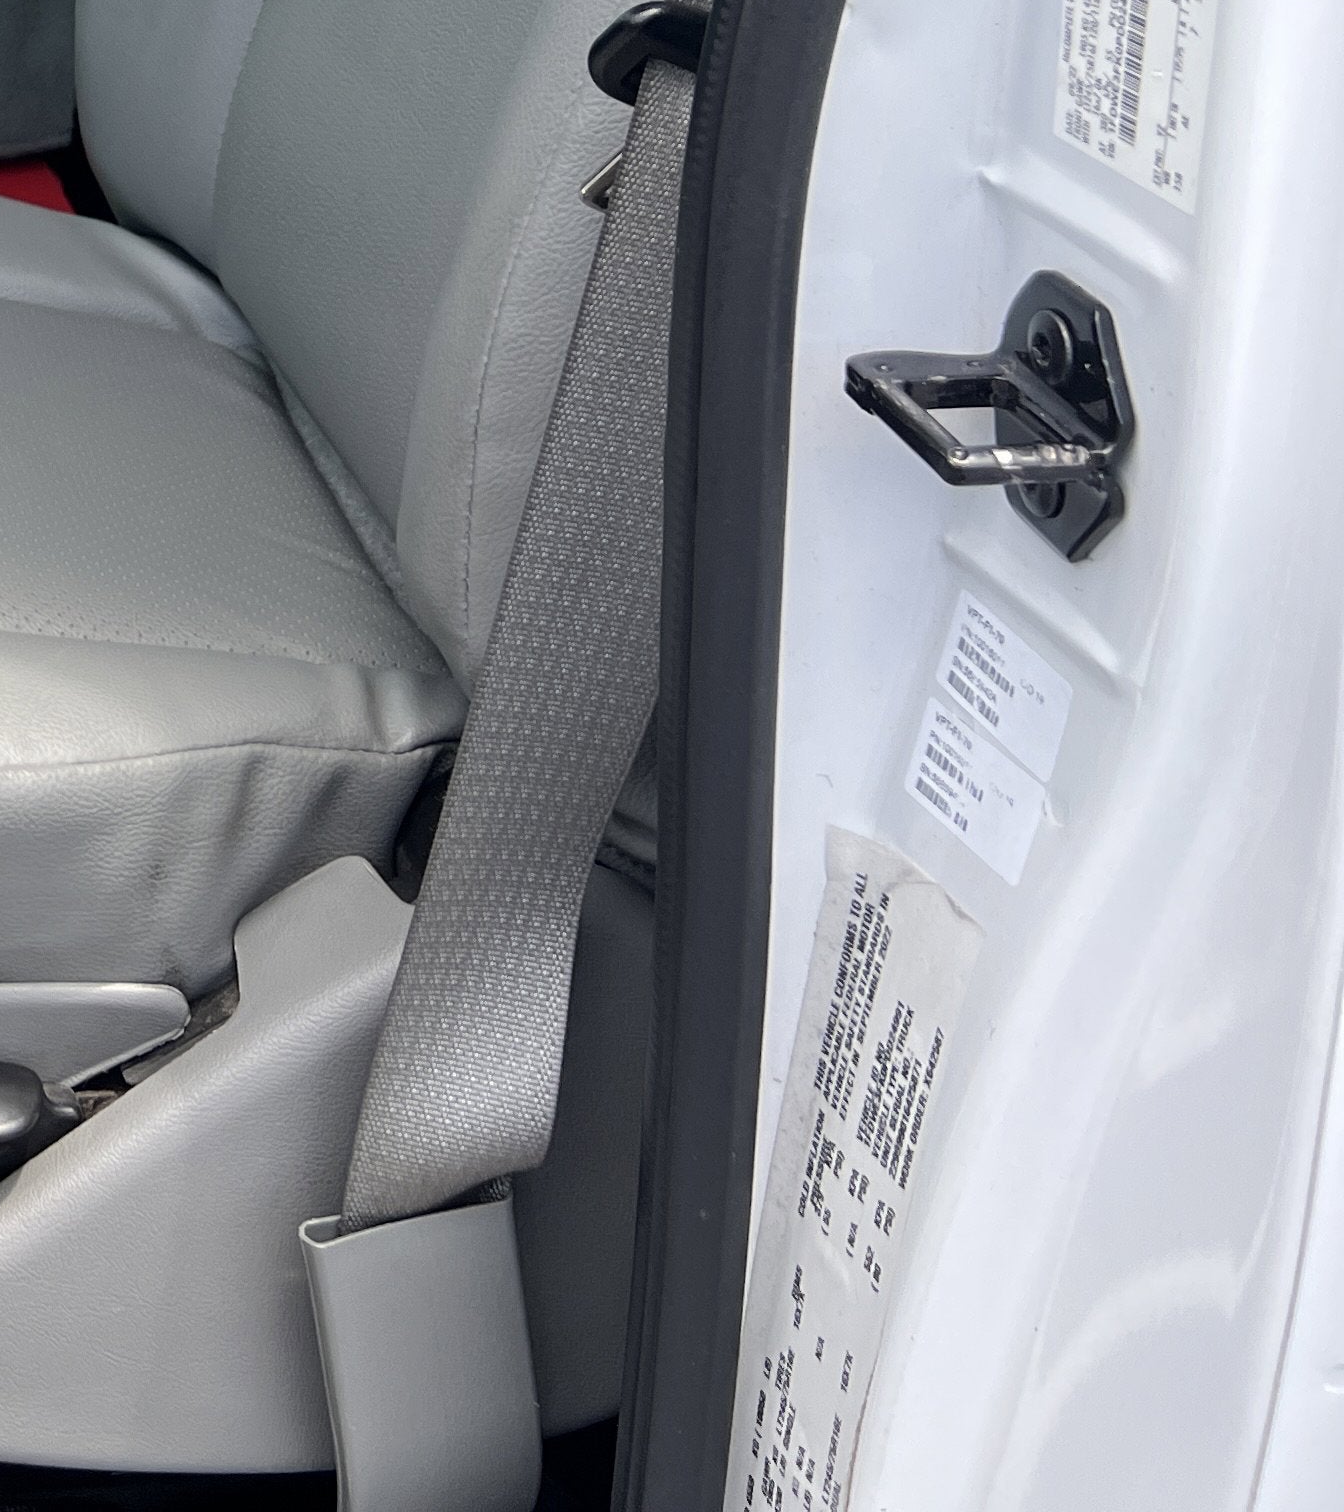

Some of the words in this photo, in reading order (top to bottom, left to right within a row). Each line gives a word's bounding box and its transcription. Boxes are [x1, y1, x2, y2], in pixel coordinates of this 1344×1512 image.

[1061, 5, 1073, 63] INCOMPLETE
[849, 896, 862, 920] TO
[854, 872, 869, 899] ALL
[832, 918, 858, 999] CONFORMS
[820, 998, 840, 1058] VEHICLE
[821, 1018, 846, 1102] APPLICABLE
[840, 955, 860, 1018] FEDERAL
[854, 898, 874, 955] MOTOR
[829, 1051, 849, 1111] VEHICLE
[843, 996, 861, 1052] SAFETY
[856, 908, 884, 999] STANDARDS
[878, 890, 889, 912] IN
[838, 1067, 856, 1121] EFFECT
[849, 1047, 860, 1068] IN
[855, 958, 882, 1046] SEPTEMBER
[877, 921, 892, 961] 2022
[812, 1055, 827, 1092] THIS
[855, 1082, 875, 1143] VEHICLE
[869, 1063, 879, 1083] ID
[870, 1098, 891, 1160] VEHICLE
[885, 1054, 901, 1098] TYPE:
[895, 1002, 914, 1056] TRUCK
[879, 1131, 893, 1169] UNIT
[887, 1082, 905, 1132] SERIAL
[897, 1142, 914, 1191] WORK
[908, 1087, 928, 1147] ORDER:
[922, 1024, 945, 1091] X642587
[796, 1178, 811, 1218] COLD
[808, 1108, 826, 1180] INFLATION
[846, 1166, 859, 1197] KPA
[856, 1173, 870, 1205] PSI)
[872, 1196, 886, 1229] KPA
[882, 1204, 895, 1237] PSI)
[762, 1355, 772, 1380] LB)
